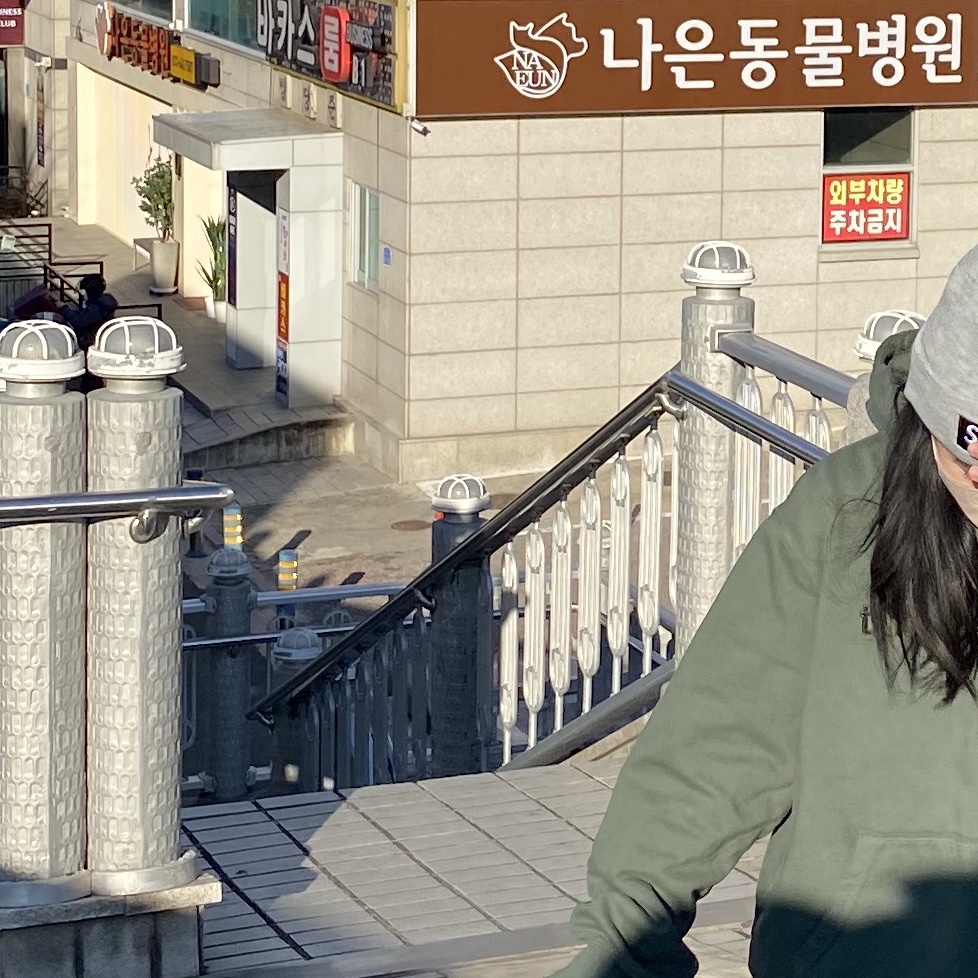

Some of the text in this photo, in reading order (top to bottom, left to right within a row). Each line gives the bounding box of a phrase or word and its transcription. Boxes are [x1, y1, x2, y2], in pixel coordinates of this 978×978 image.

[512, 51, 544, 70] NA
[600, 13, 963, 91] 나은동물병원
[514, 69, 557, 88] EUN
[829, 178, 904, 206] 외부차량
[829, 208, 902, 236] 주차금지
